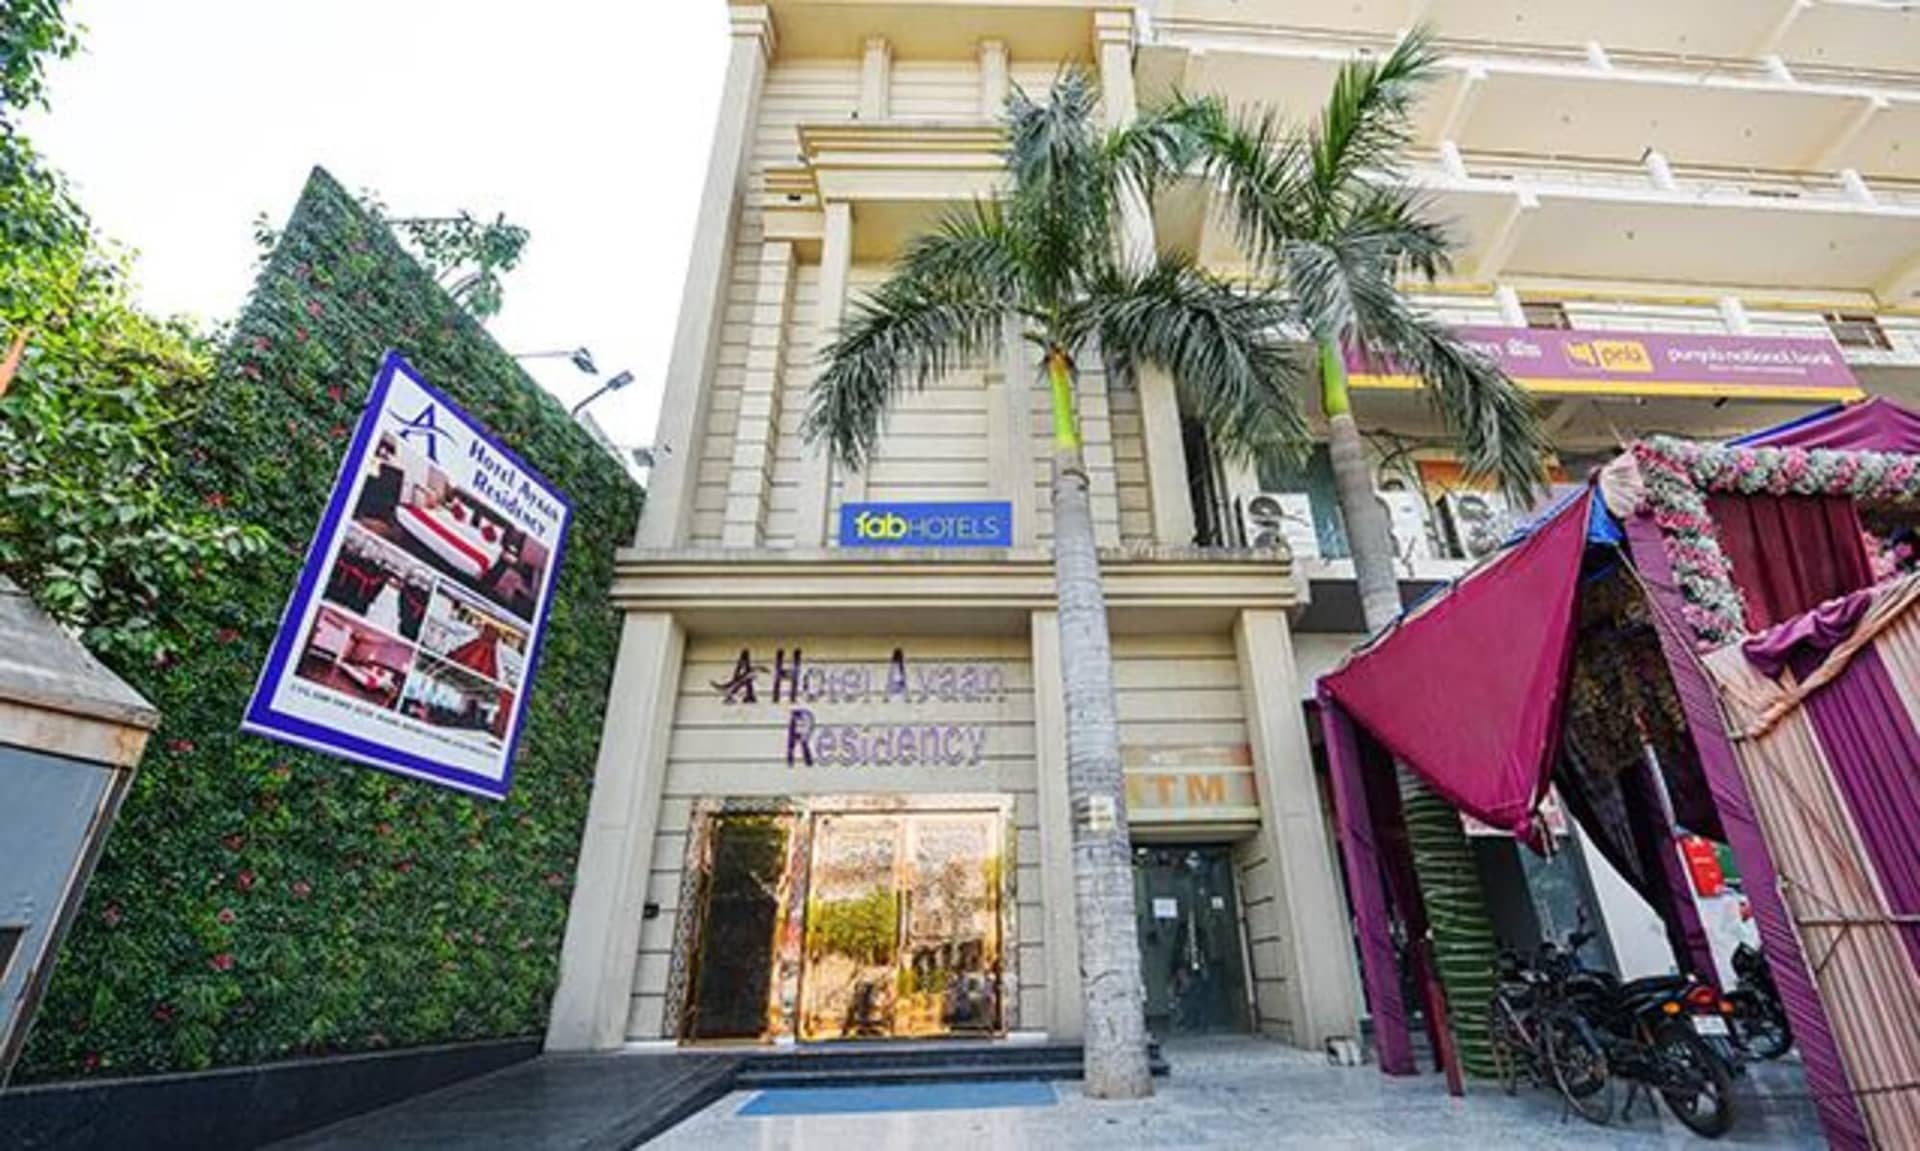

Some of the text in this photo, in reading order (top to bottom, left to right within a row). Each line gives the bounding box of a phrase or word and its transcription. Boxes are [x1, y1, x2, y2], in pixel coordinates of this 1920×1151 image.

[468, 439, 516, 488] Hotel
[471, 469, 546, 536] Residency
[772, 648, 870, 703] Hotel
[883, 648, 1007, 703] Ayaan
[786, 708, 986, 768] Residency
